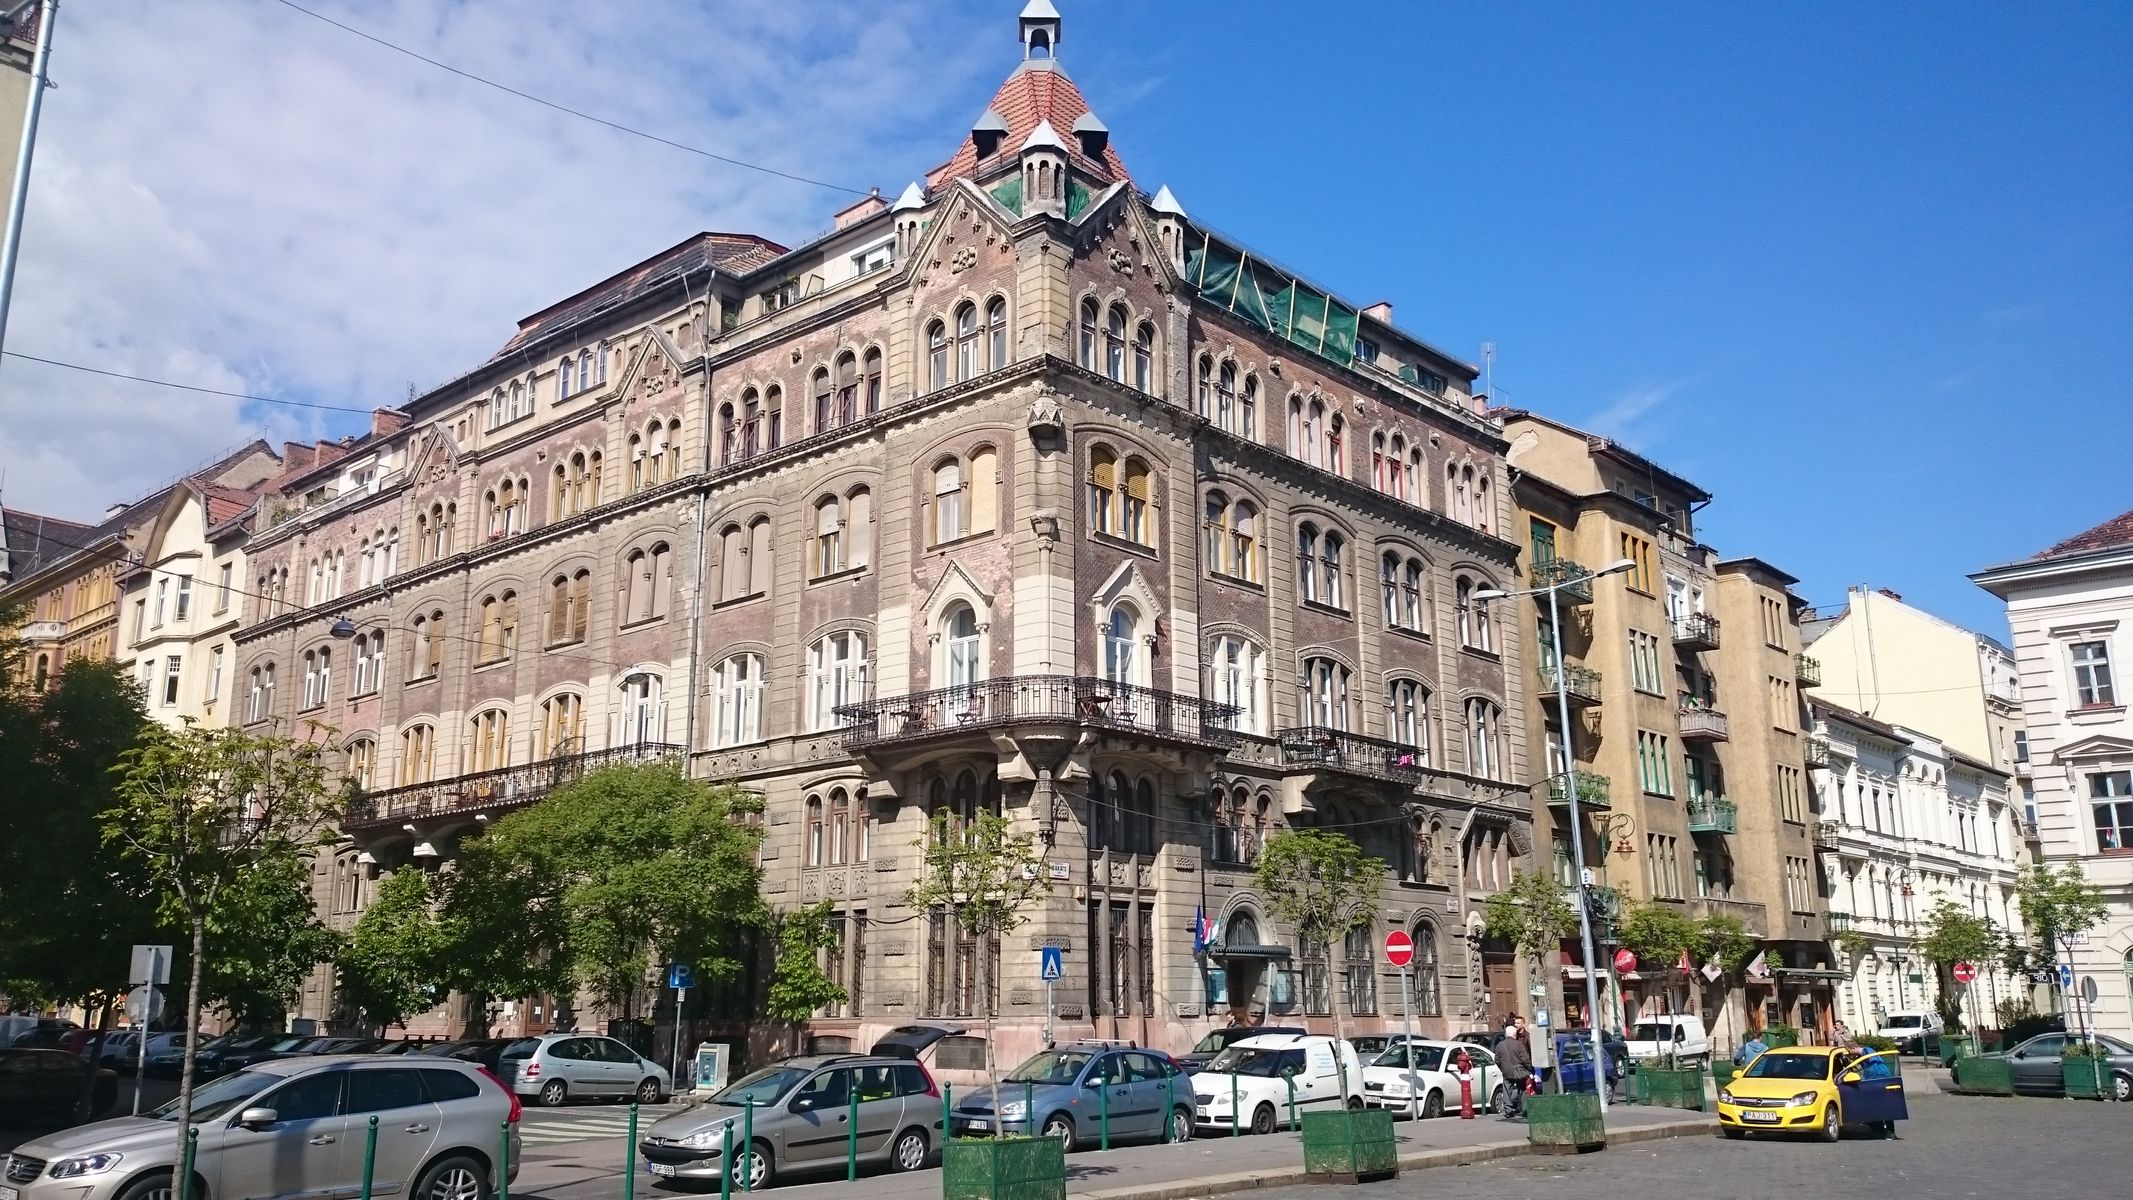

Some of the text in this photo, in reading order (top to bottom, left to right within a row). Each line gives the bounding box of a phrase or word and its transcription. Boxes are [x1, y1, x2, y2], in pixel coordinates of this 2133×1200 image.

[674, 965, 690, 984] P
[1537, 1011, 1546, 1025] P
[1747, 1111, 1775, 1120] PAJ-311
